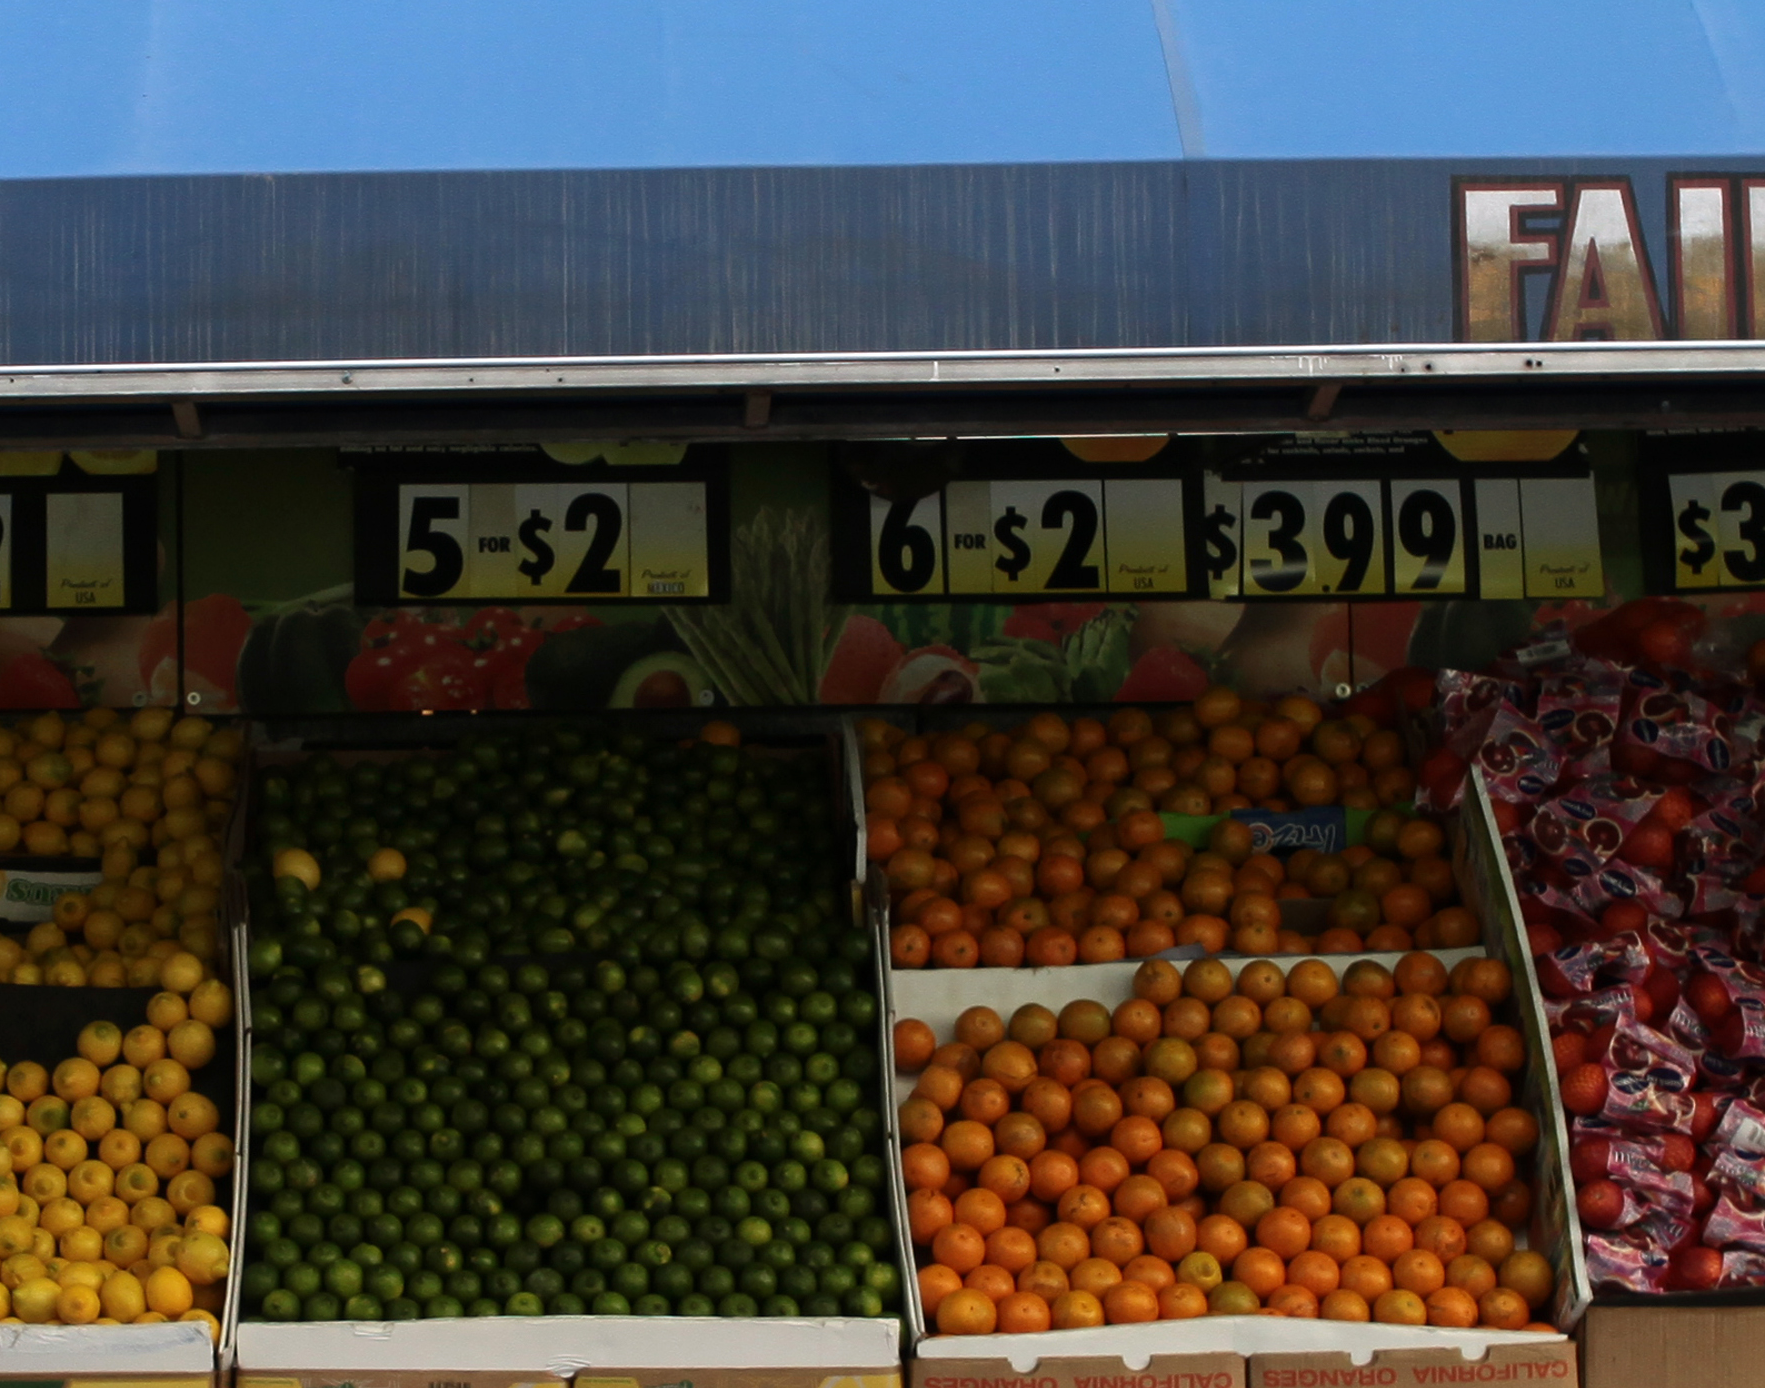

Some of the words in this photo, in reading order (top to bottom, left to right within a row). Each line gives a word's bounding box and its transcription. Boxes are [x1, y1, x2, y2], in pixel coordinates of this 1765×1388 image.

[403, 497, 463, 597] 5
[478, 536, 510, 553] FOR
[518, 492, 622, 593] $2
[878, 499, 935, 593] 6
[953, 532, 986, 551] FOR
[993, 490, 1099, 591] $2
[1203, 489, 1456, 593] $3.99
[1483, 531, 1518, 551] BAG
[75, 591, 96, 605] USA
[1262, 1367, 1398, 1388] ORANGES
[1413, 1359, 1569, 1385] CALIFORNIA
